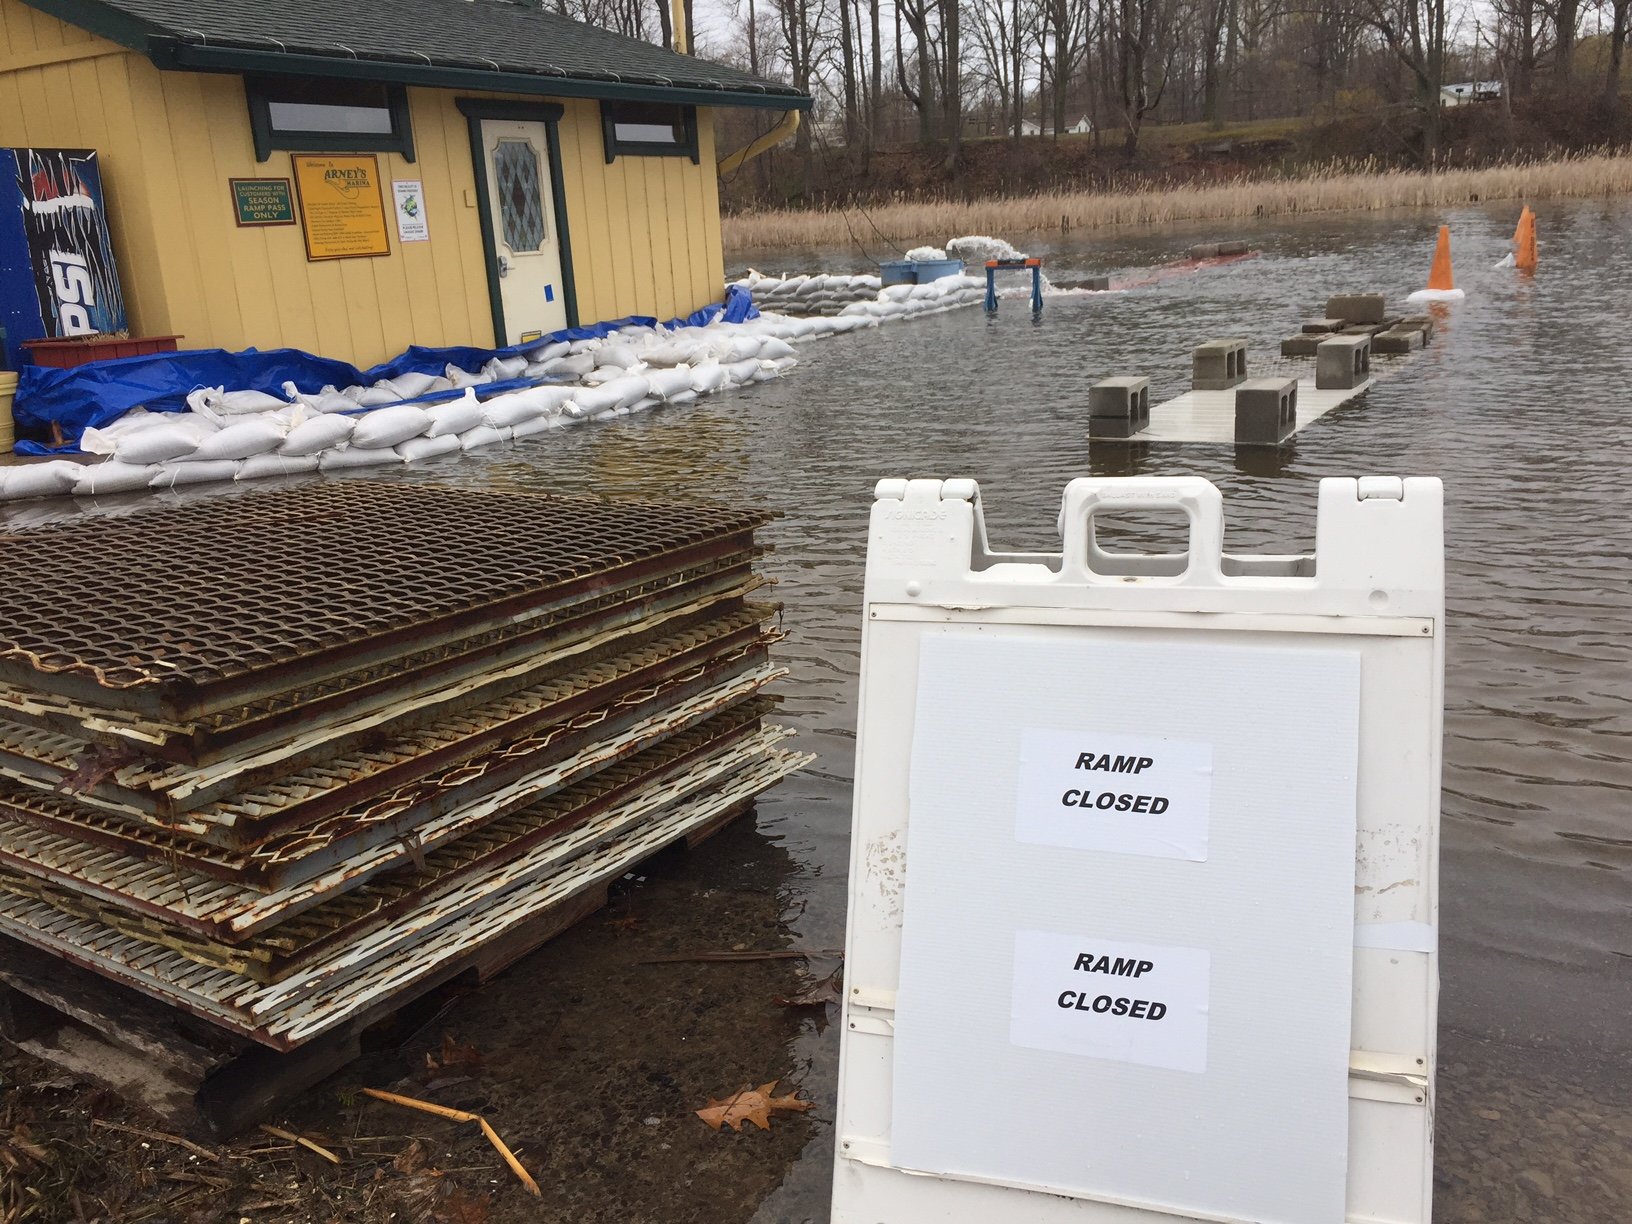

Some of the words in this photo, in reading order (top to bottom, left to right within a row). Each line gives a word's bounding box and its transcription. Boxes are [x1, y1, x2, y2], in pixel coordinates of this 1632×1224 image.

[324, 166, 367, 180] ARNEY'S
[243, 204, 266, 212] RAMP
[248, 196, 280, 204] SEASON
[253, 211, 279, 219] ONLY
[1074, 752, 1154, 775] RAMP
[1061, 789, 1169, 815] CLOSED
[1073, 953, 1154, 978] RAMP
[1057, 990, 1167, 1021] CLOSED
